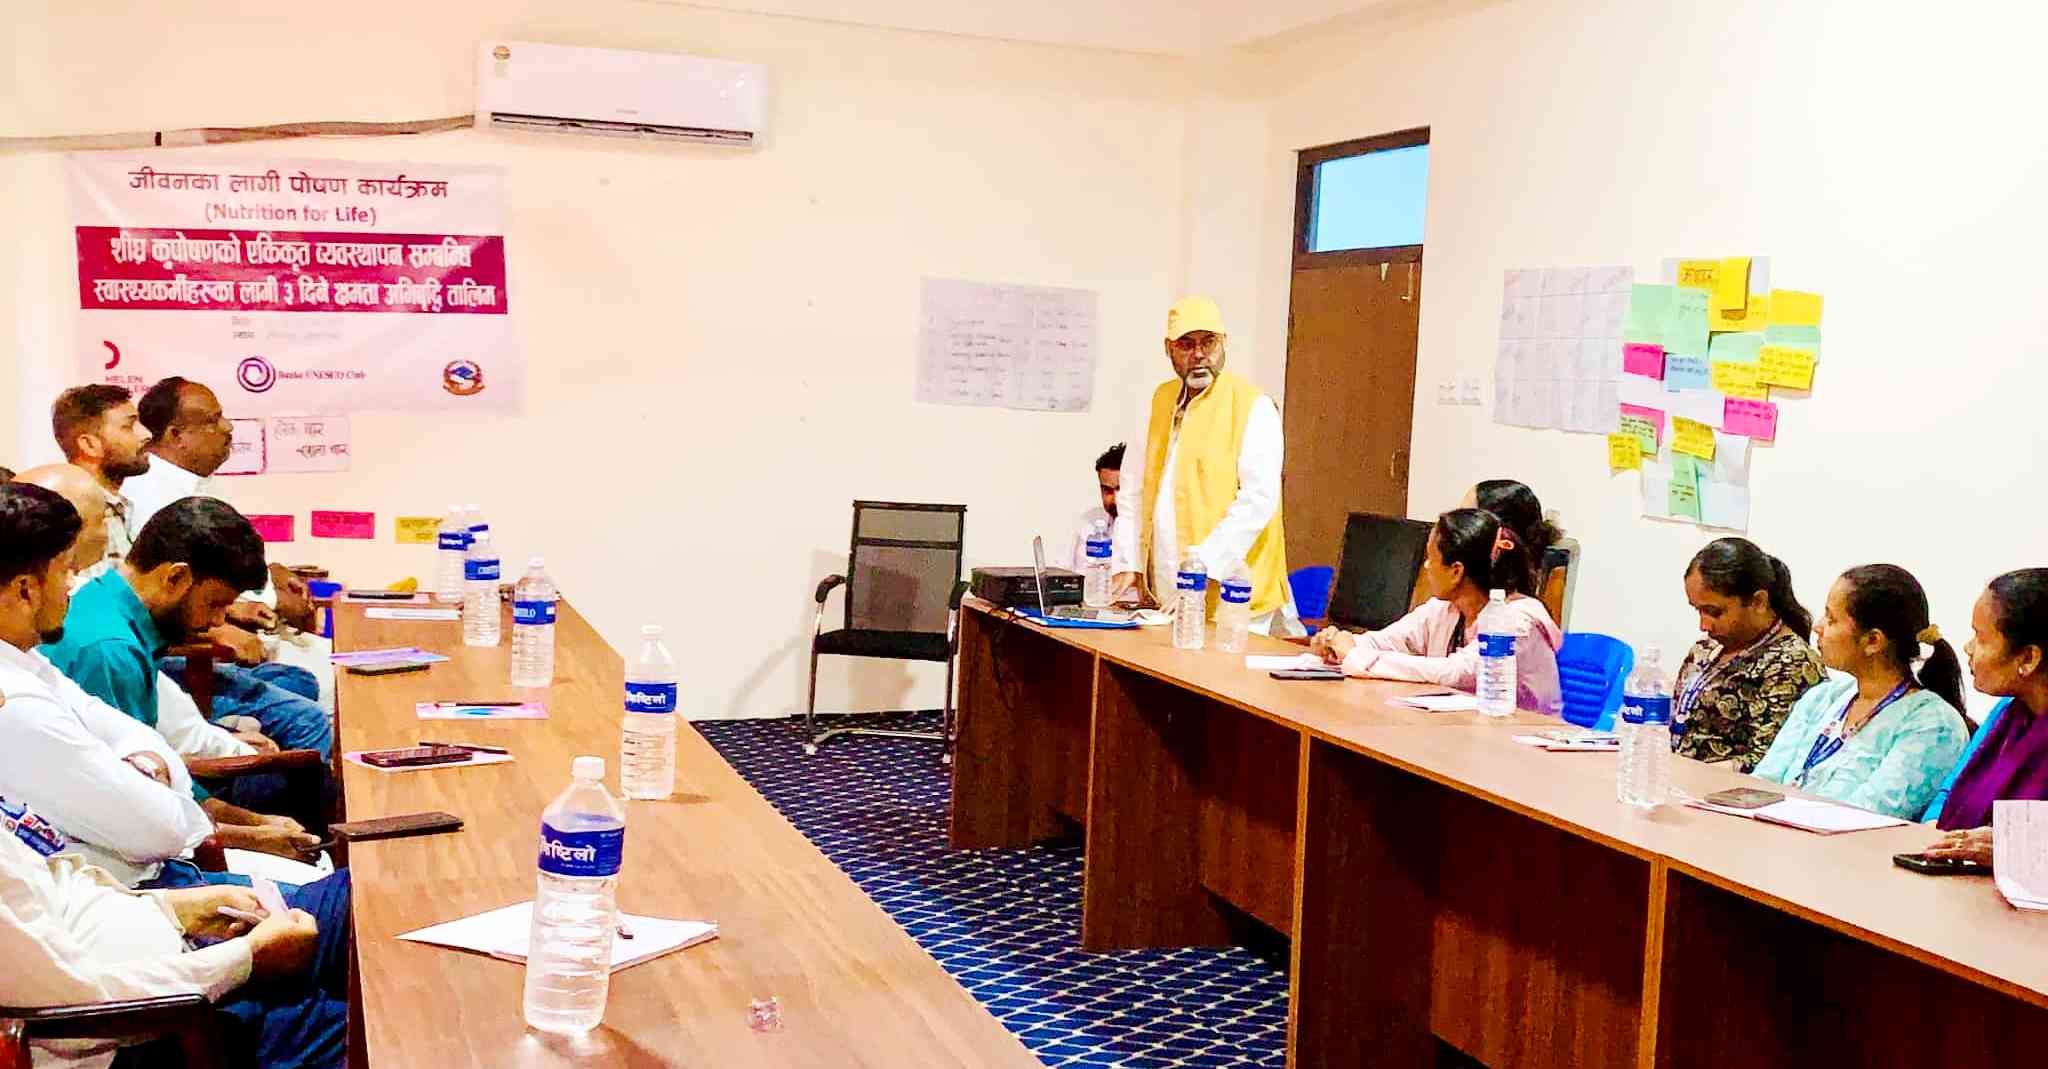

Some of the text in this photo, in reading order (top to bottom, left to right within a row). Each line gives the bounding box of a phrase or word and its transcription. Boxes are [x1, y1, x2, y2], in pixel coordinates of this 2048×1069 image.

[128, 166, 448, 198] जीवनका लागी पोषण कार्यक्रम
[205, 203, 377, 226] (Nutrition for Life)
[316, 242, 403, 268] व्यवस्थापन
[239, 275, 279, 304] लागी
[283, 281, 294, 305] ३
[298, 275, 329, 305] दिने
[333, 283, 380, 306] क्षमता
[446, 277, 496, 307] तालिम
